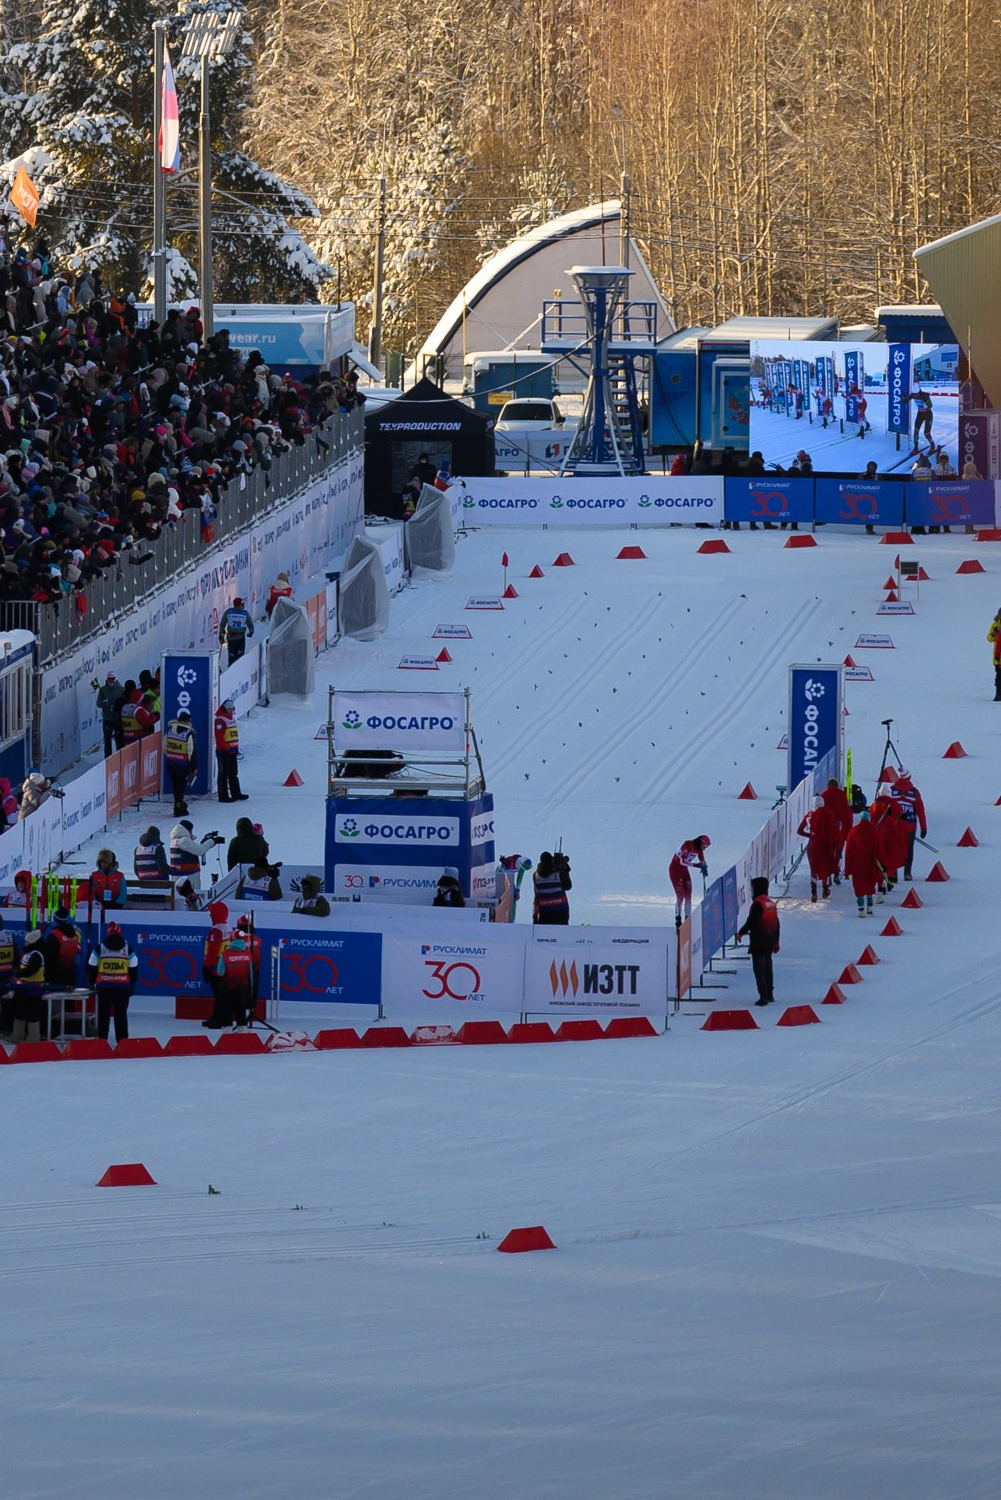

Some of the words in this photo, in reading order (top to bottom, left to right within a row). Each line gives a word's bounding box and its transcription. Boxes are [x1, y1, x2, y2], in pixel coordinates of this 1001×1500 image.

[892, 367, 903, 426] ФОСАГРО
[495, 448, 520, 457] АГРО
[478, 499, 537, 509] ФОСАГРО
[566, 498, 625, 508] ФОСАГРО
[654, 498, 713, 508] ФОСАГРО
[750, 491, 788, 518] 30
[838, 493, 878, 520] 30
[929, 495, 967, 521] 30
[366, 716, 454, 730] ФОСАГРО
[804, 704, 820, 776] ФОСАГ
[364, 824, 450, 840] ФОСАГРО
[344, 874, 364, 888] 30
[383, 878, 439, 888] РУСКЛИМ
[149, 934, 203, 943] РУСКЛИМАТ
[290, 939, 345, 949] РУСКЛИМАТ
[433, 945, 487, 956] РУСКЛИМАТ
[140, 949, 197, 988] 30
[280, 953, 339, 994] 30
[184, 981, 203, 989] ЛЕТ
[422, 960, 481, 1000] 30
[583, 964, 640, 995] ИЗТТ
